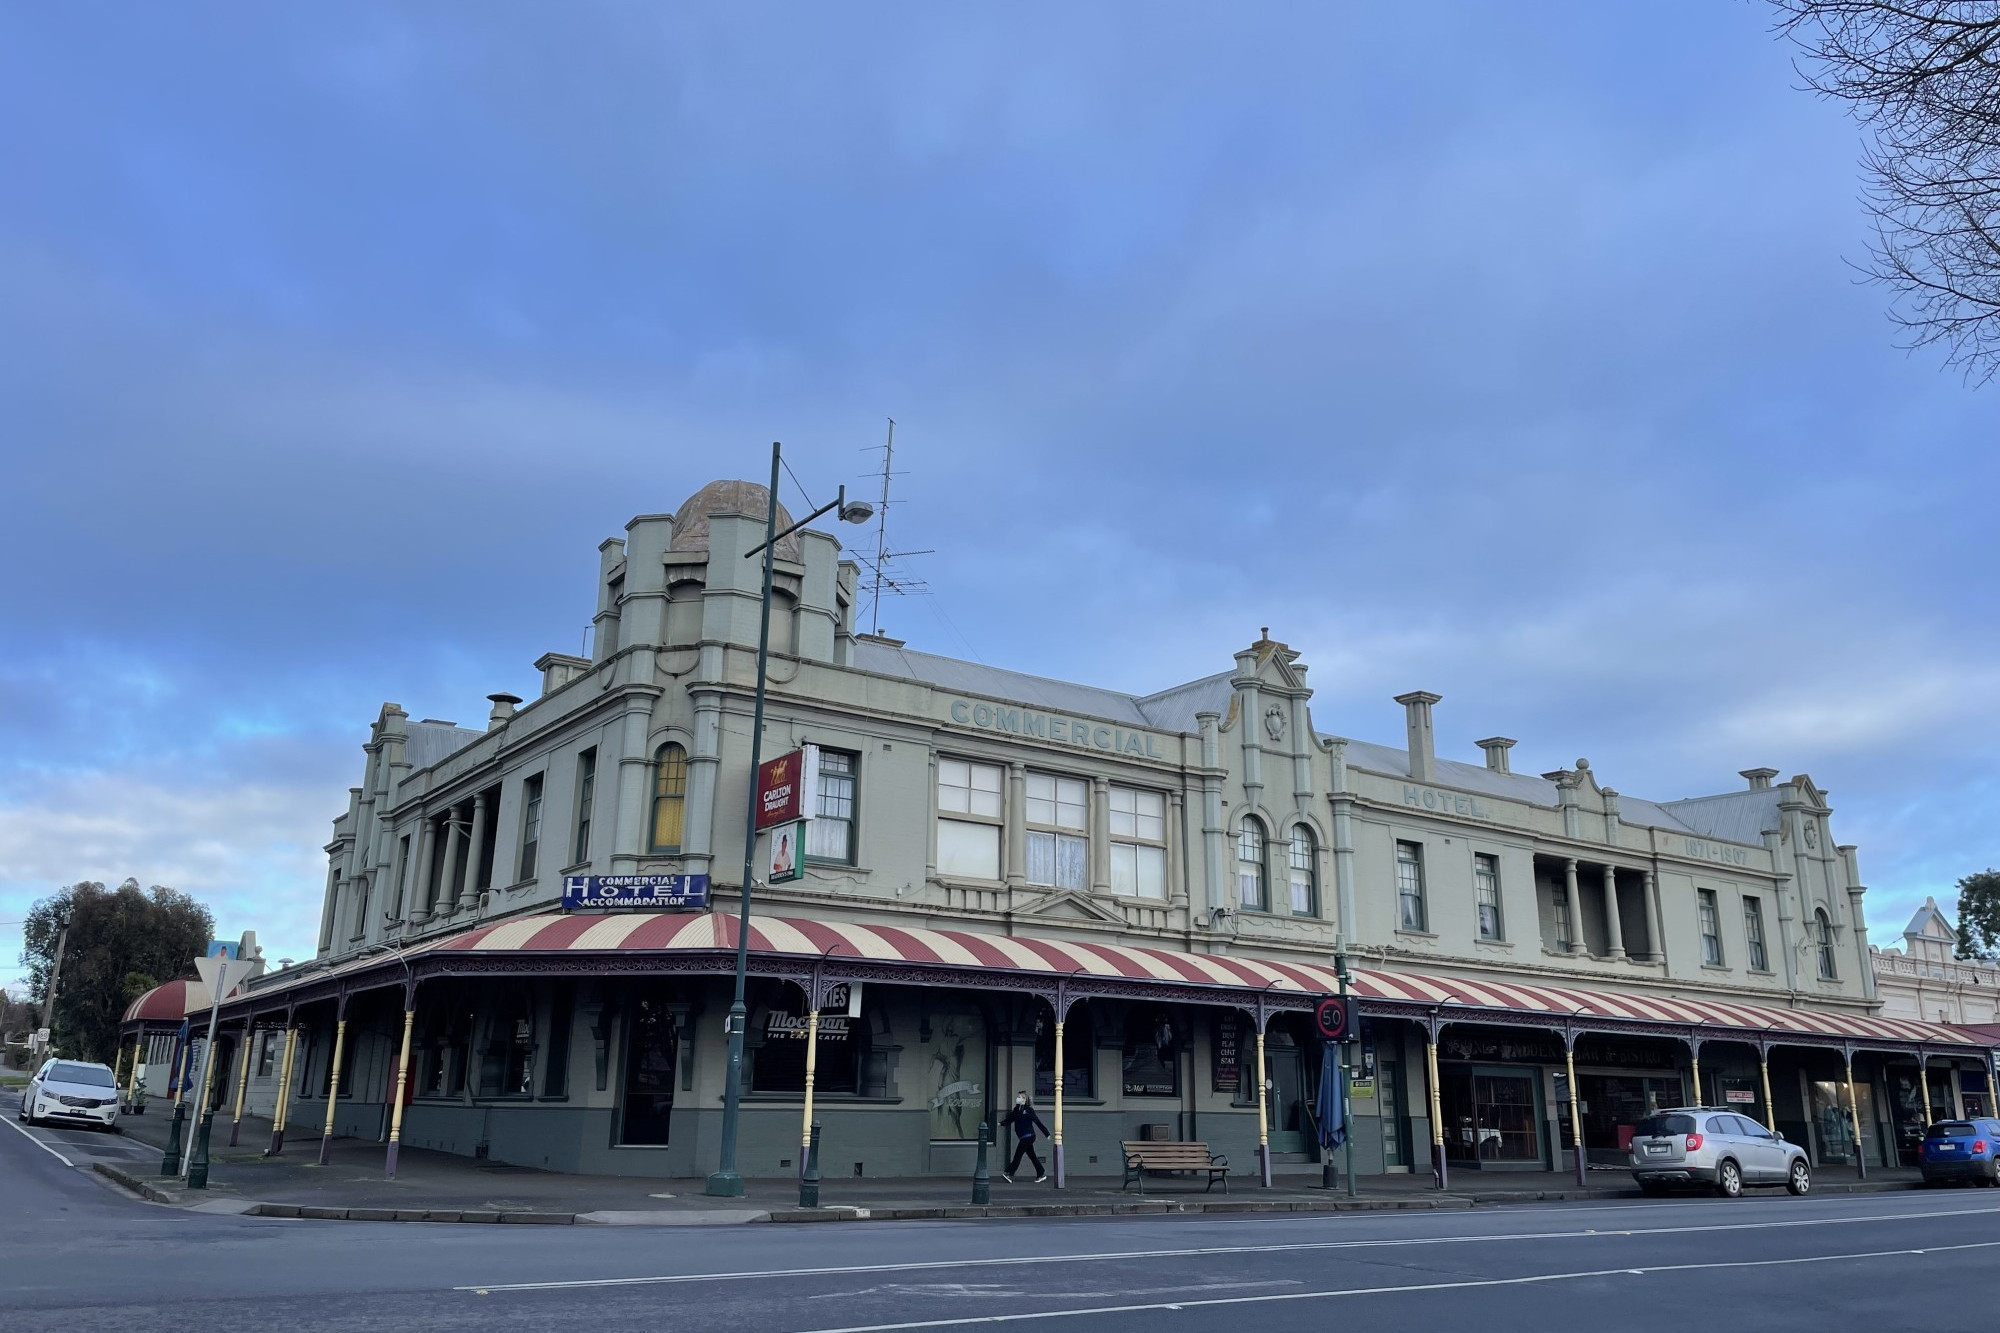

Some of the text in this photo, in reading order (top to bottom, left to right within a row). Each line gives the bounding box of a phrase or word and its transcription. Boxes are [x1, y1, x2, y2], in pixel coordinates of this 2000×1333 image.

[950, 700, 1162, 759] COMMERCIAL
[763, 784, 792, 803] CARLTON
[764, 796, 789, 812] DRAUGHT
[566, 876, 705, 898] HOTEL
[599, 876, 678, 887] COMMERCIAL
[583, 897, 686, 907] ACCOMMODATION
[1323, 1010, 1341, 1025] 50
